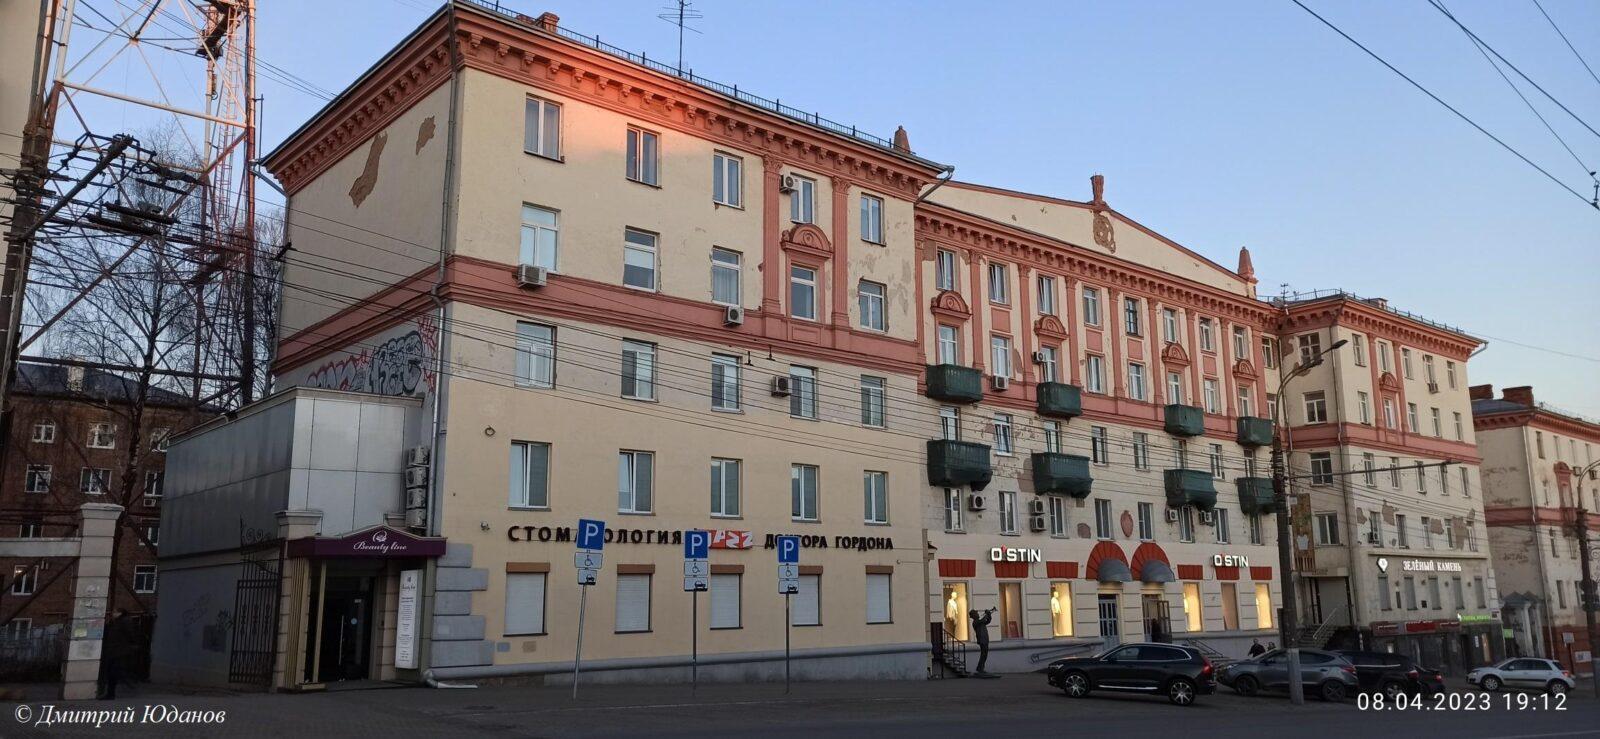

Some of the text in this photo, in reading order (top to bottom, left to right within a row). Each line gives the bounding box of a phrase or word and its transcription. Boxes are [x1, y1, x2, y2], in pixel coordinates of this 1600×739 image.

[507, 525, 682, 545] СТОМОЛОГИЯ
[584, 523, 599, 545] P
[764, 534, 894, 551] ДОРА ГОРДОНА
[353, 541, 389, 553] Beauty
[691, 534, 703, 555] P
[783, 539, 795, 560] P
[991, 544, 1041, 562] O'STIN
[1402, 560, 1462, 571] ЗЕЛЁНЫЙ КАМЕНЬ
